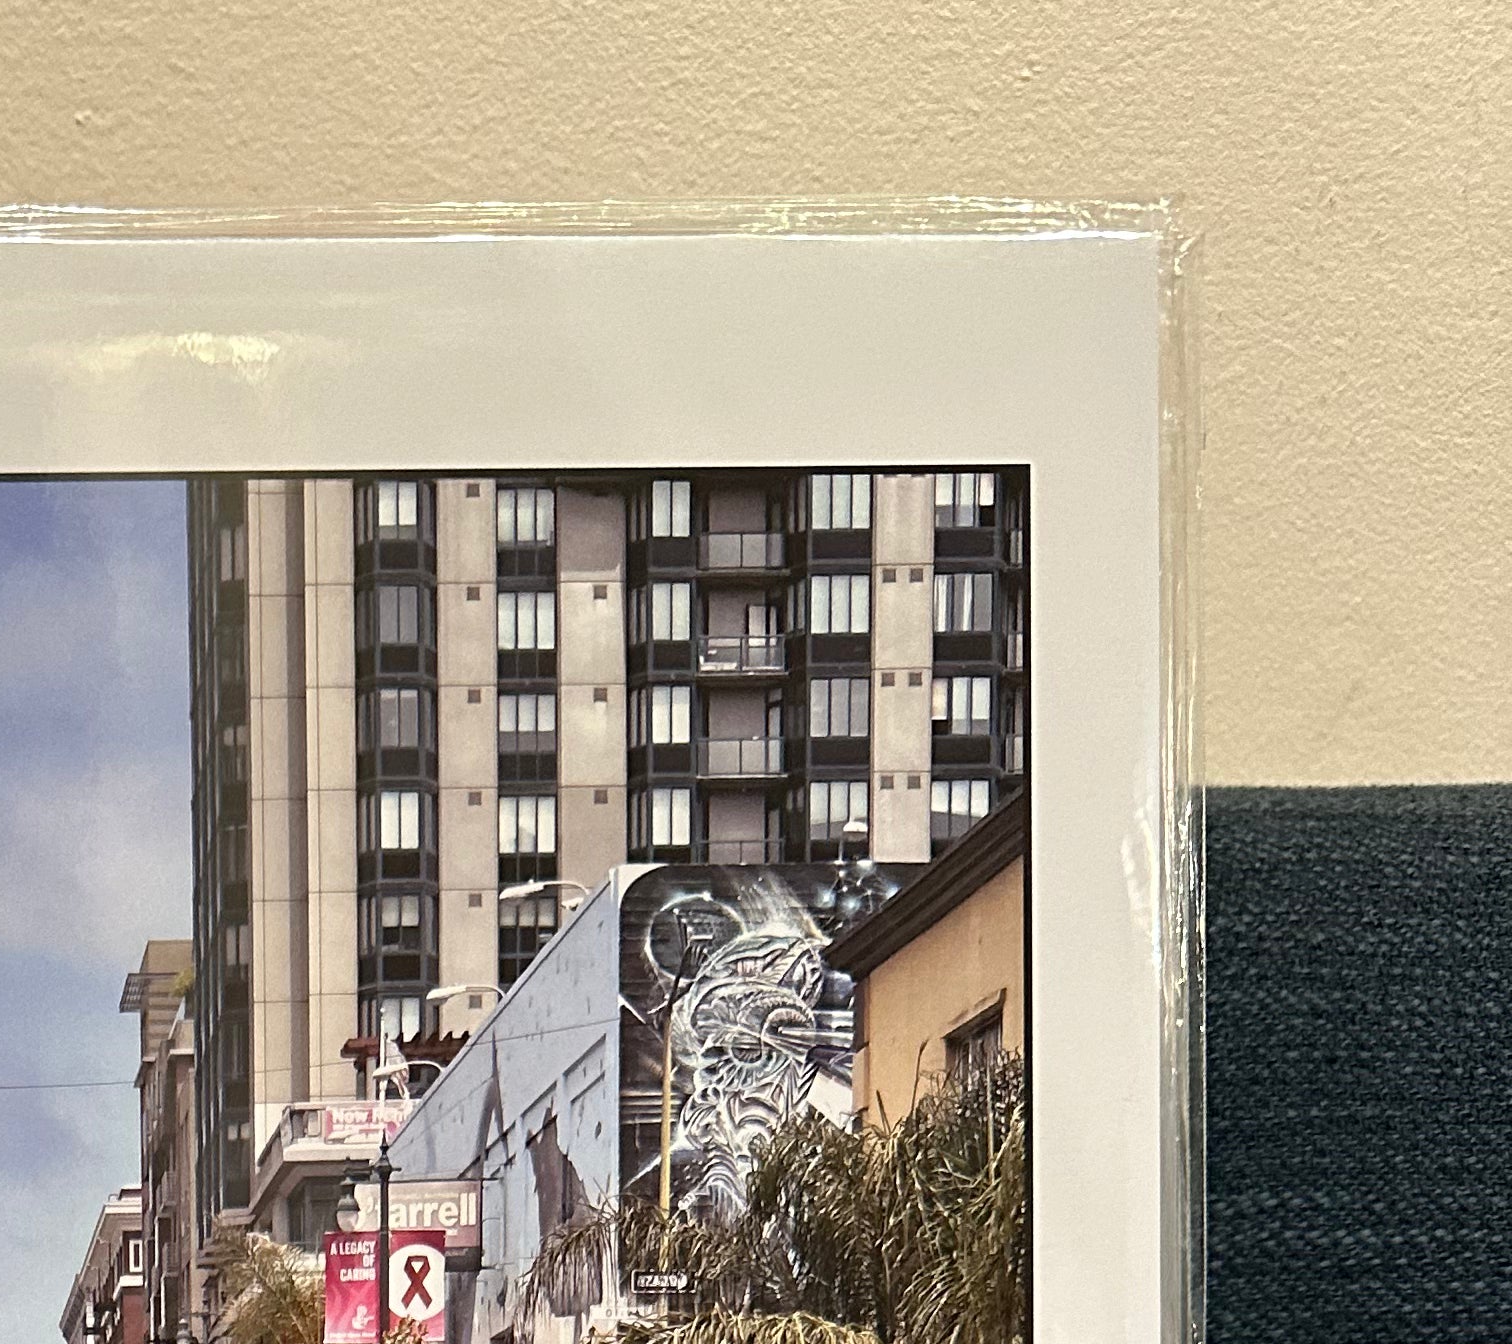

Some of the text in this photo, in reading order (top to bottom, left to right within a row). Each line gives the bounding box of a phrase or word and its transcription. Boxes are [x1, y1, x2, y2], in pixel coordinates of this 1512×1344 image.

[330, 1241, 376, 1255] A LEGACY
[363, 1255, 376, 1267] OF
[340, 1268, 376, 1282] CARING
